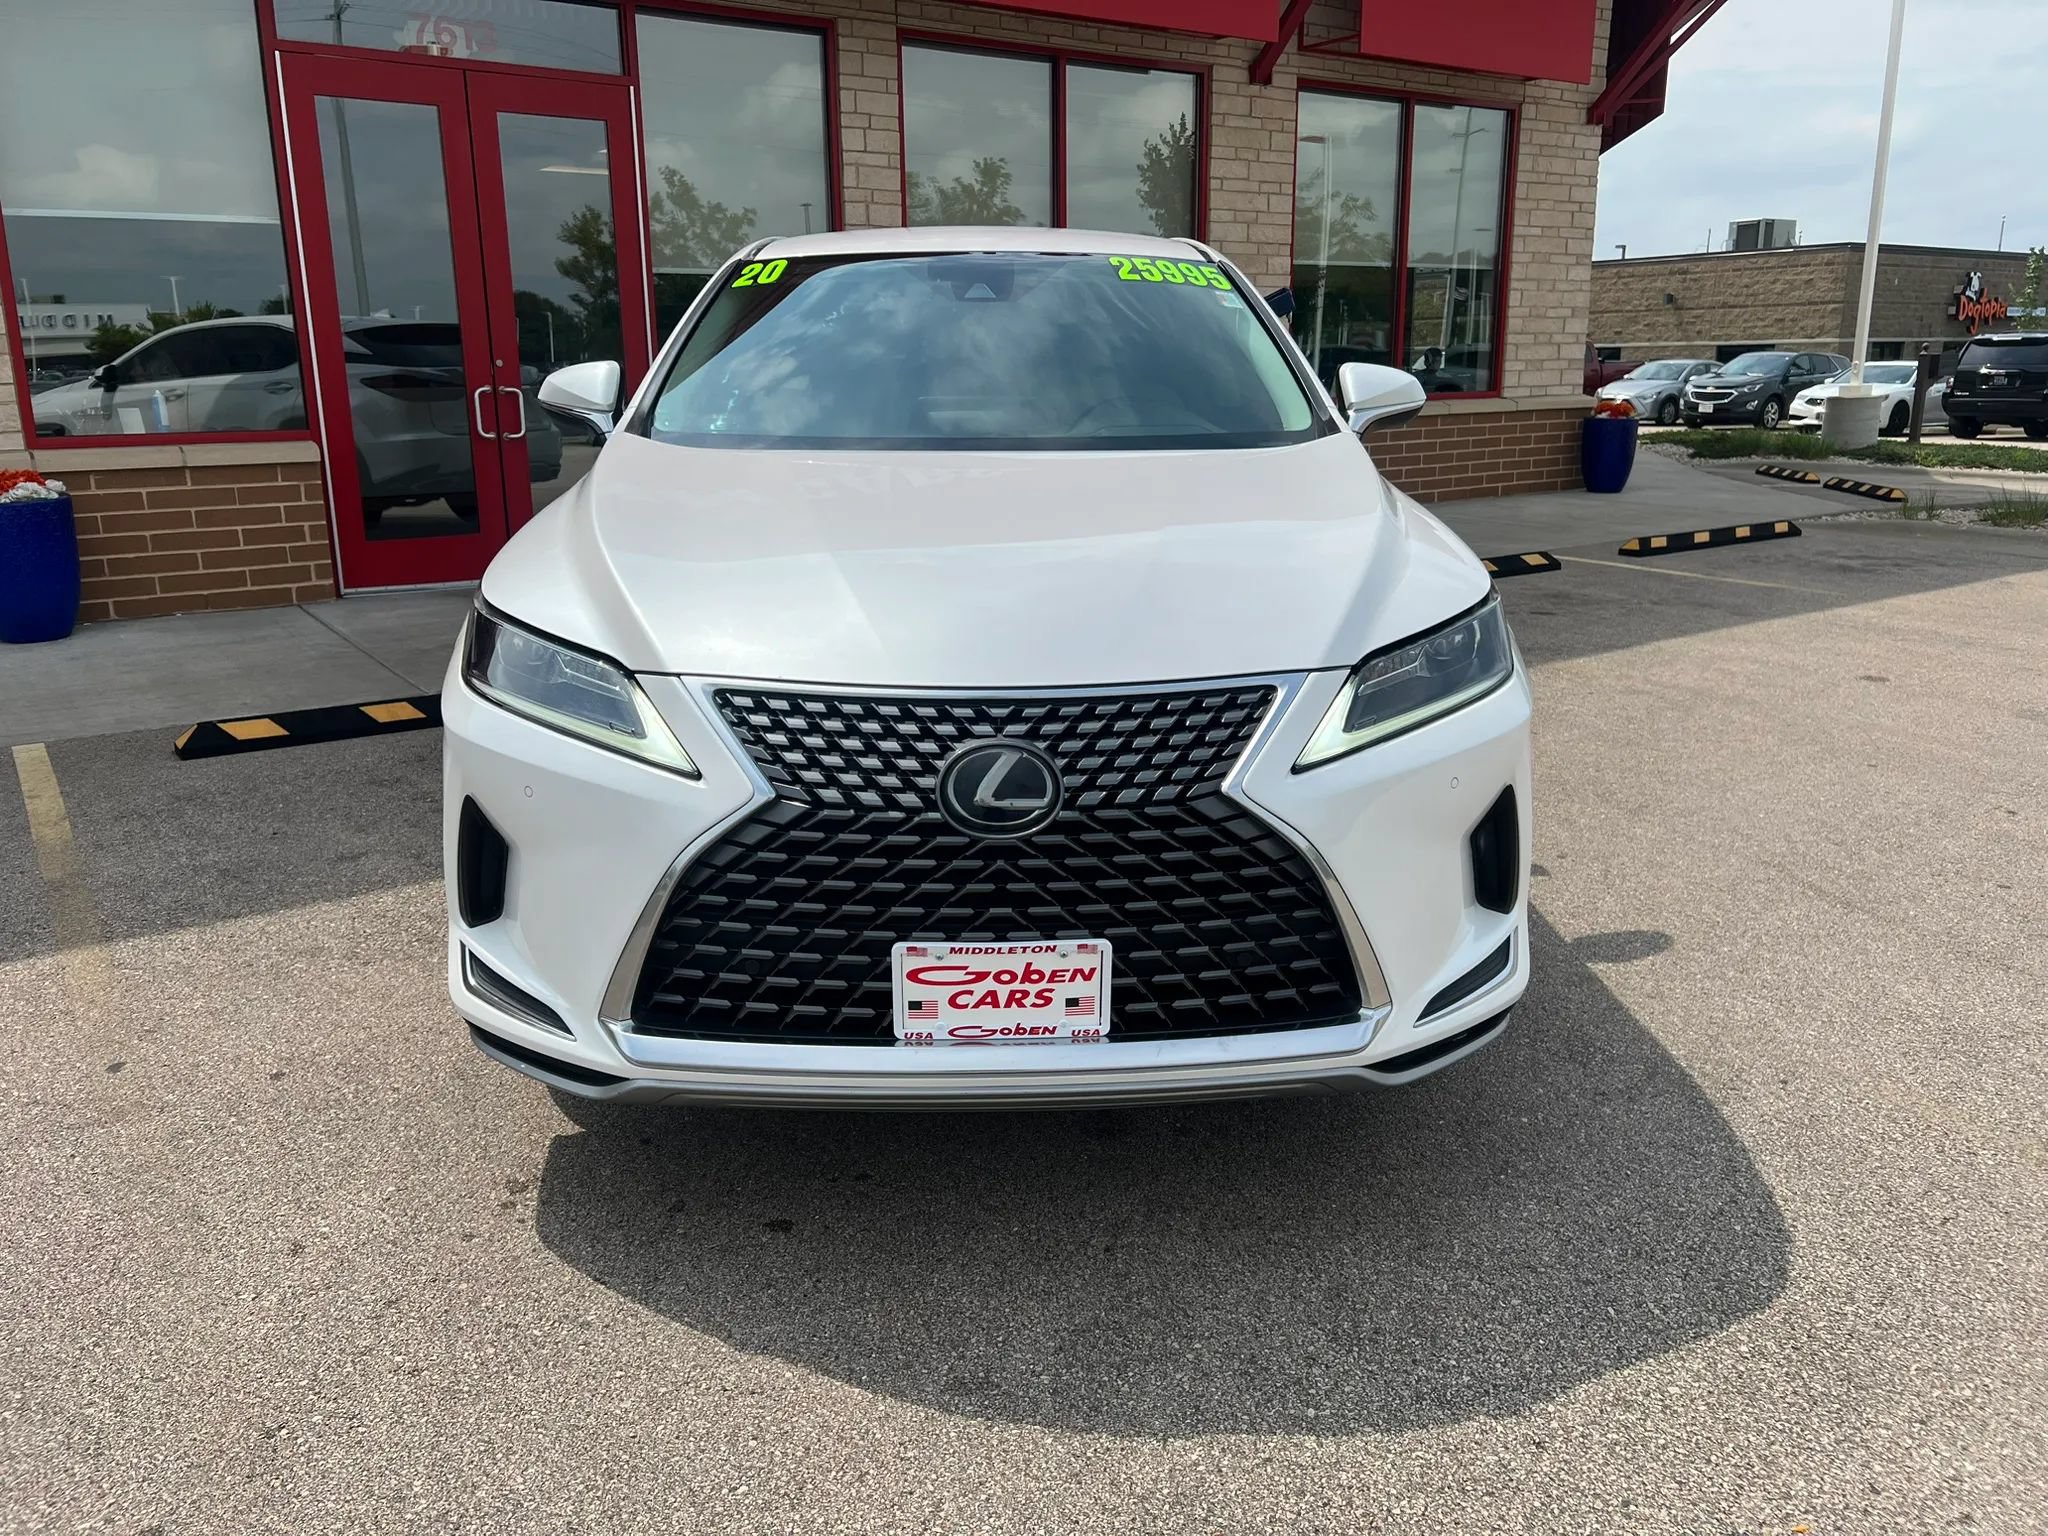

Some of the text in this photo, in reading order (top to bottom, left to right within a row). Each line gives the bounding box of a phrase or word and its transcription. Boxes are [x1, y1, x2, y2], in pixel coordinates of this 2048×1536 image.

[731, 259, 788, 288] 20
[1108, 256, 1232, 290] 25995
[1959, 288, 2008, 335] Dogtopia
[949, 945, 1058, 956] MIDDLETON
[947, 988, 1056, 1010] CARS
[904, 1032, 934, 1041] USA
[1071, 1028, 1101, 1038] USA
